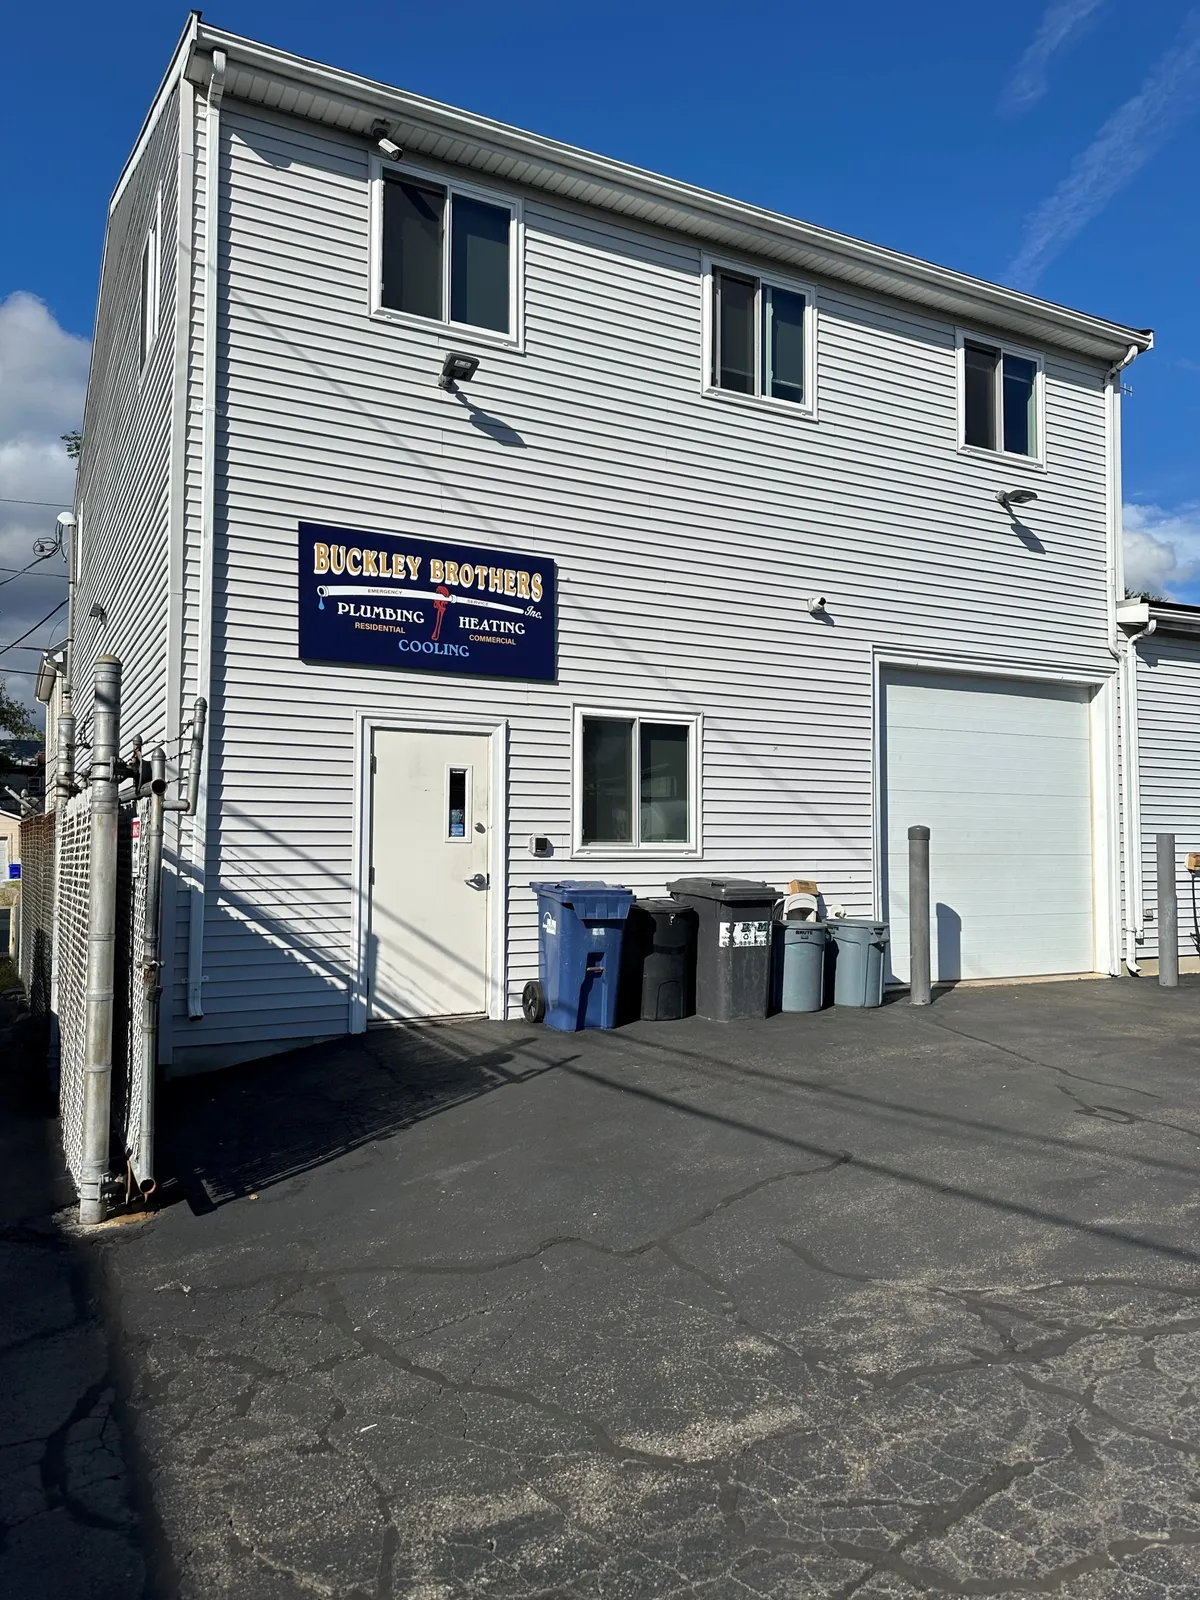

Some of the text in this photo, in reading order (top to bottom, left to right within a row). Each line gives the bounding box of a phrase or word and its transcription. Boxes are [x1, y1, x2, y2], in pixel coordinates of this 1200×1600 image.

[313, 542, 544, 602] BUCKLEY BROTHERS
[466, 599, 489, 607] SERVICE
[524, 605, 543, 619] Inc.
[337, 602, 526, 635] PLUMBING HEATING
[354, 621, 517, 646] RESIDENTIAL COMMERCIAL
[398, 639, 470, 657] COOLING
